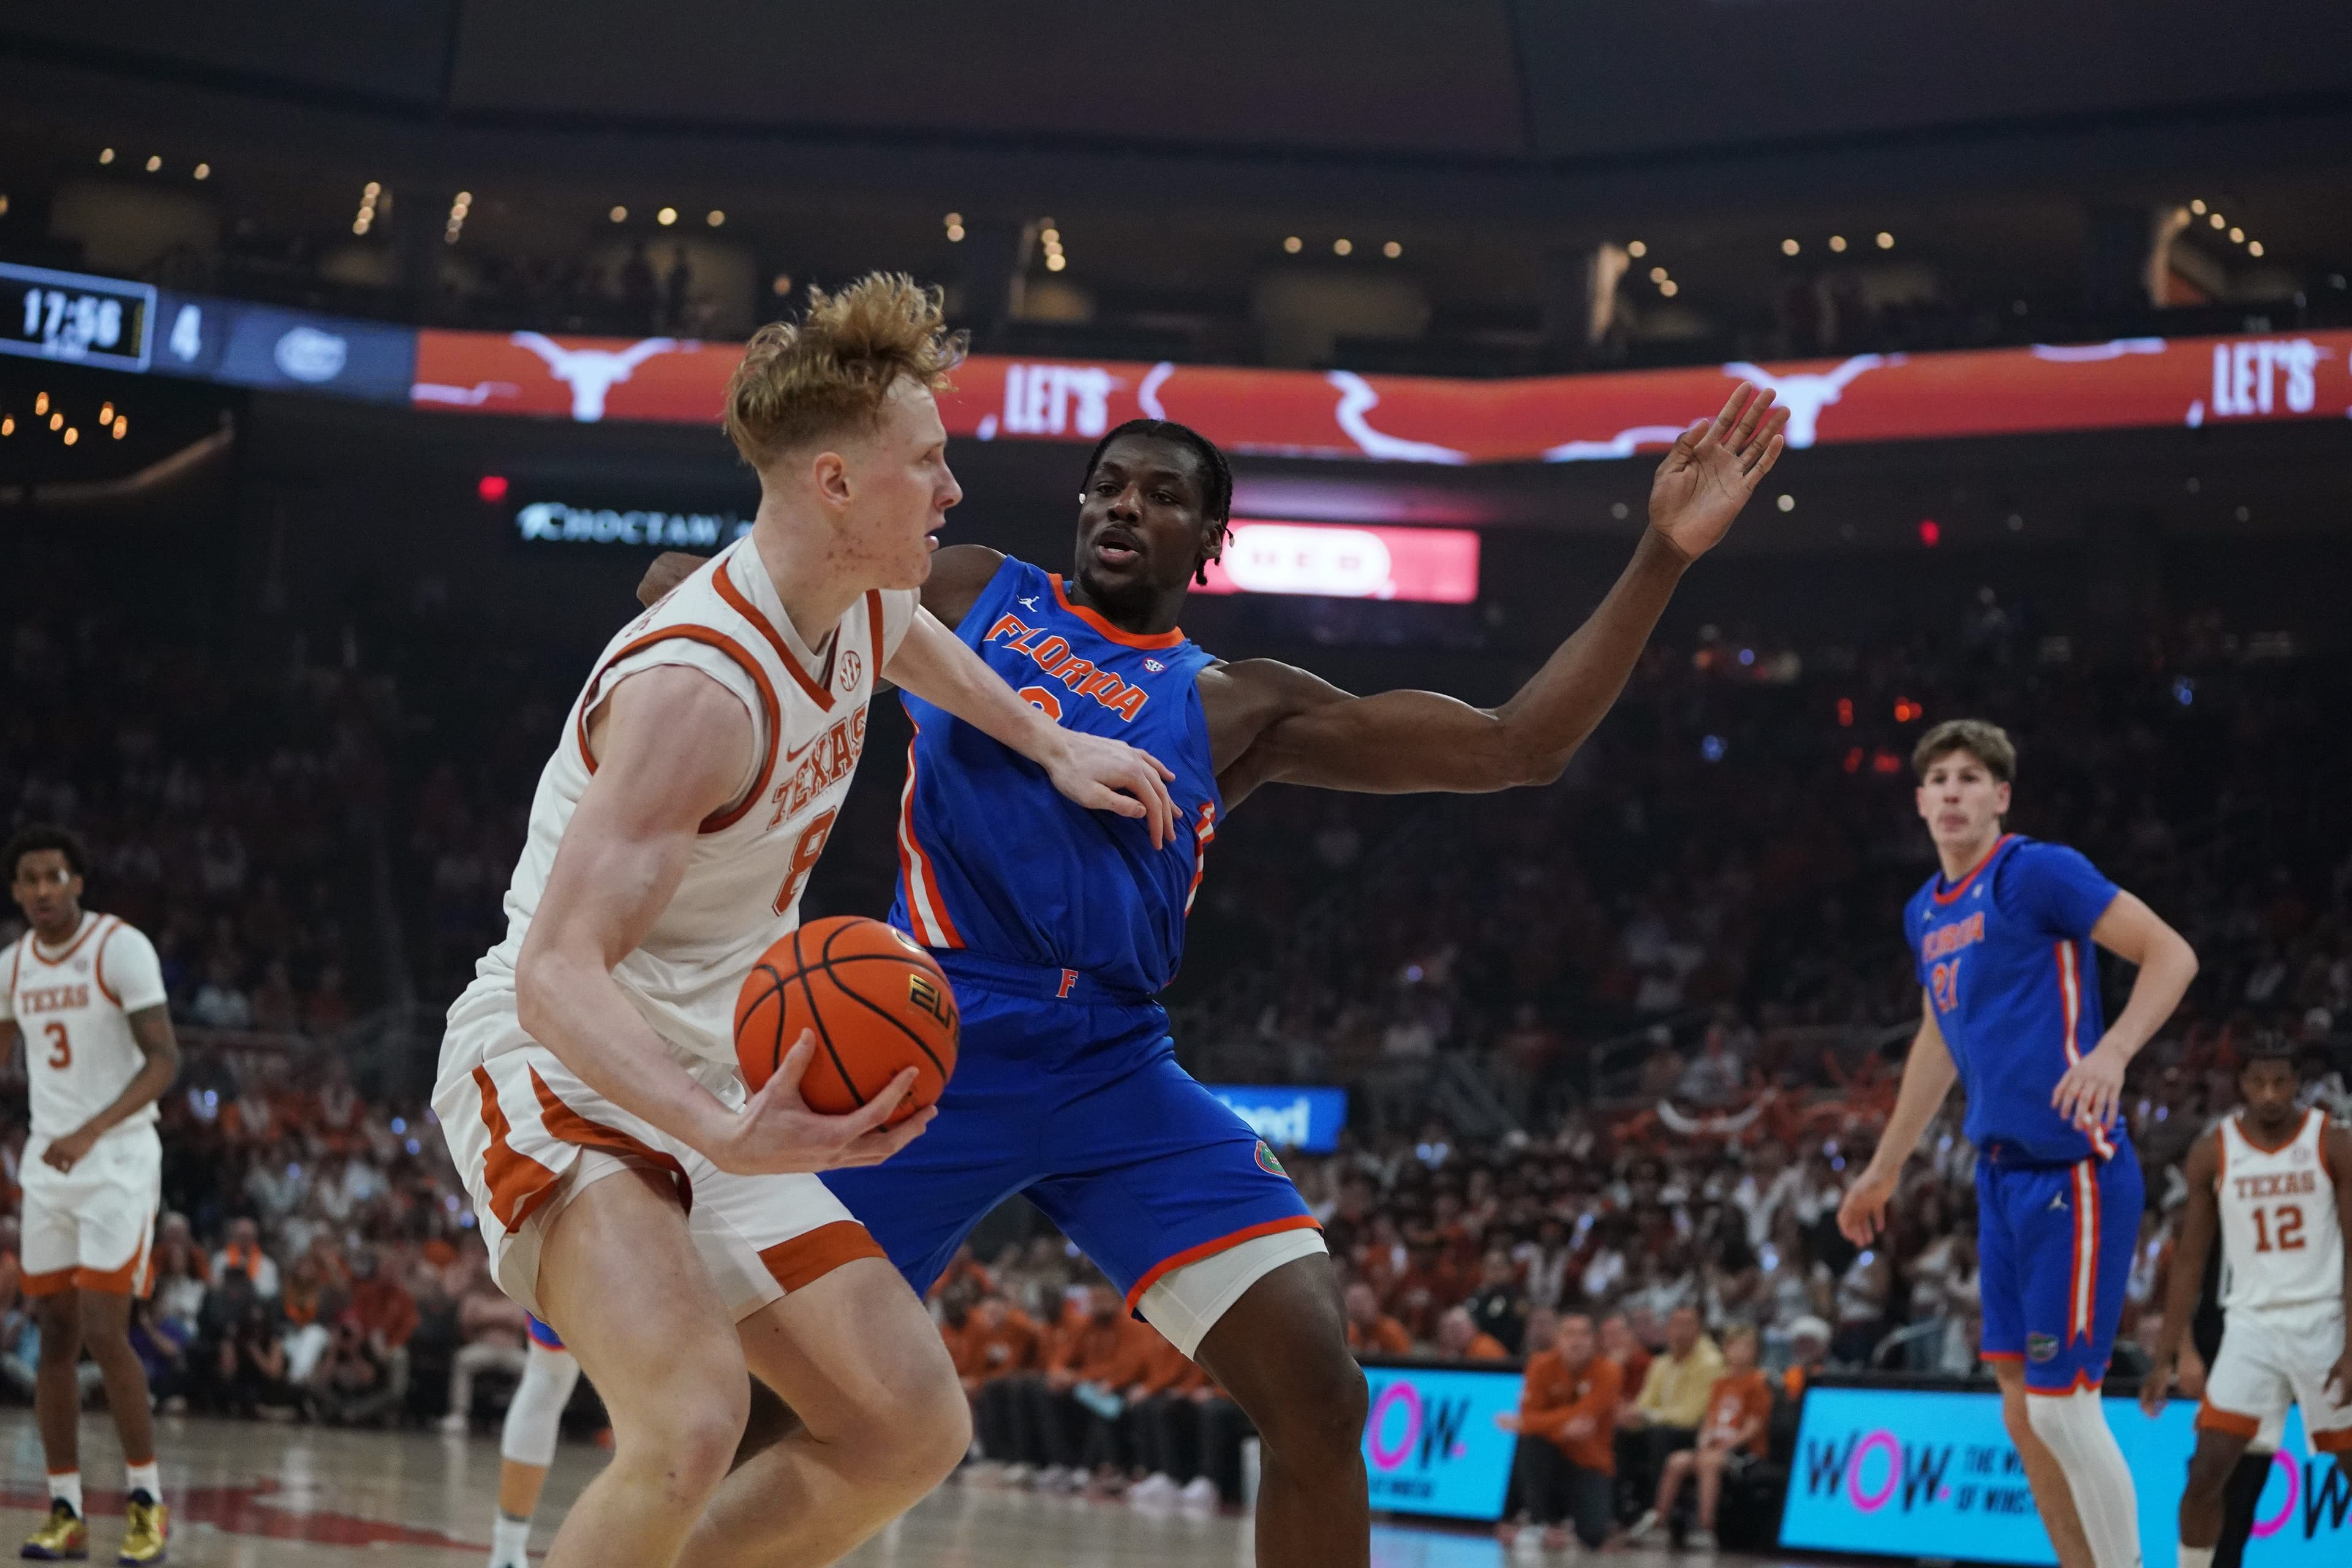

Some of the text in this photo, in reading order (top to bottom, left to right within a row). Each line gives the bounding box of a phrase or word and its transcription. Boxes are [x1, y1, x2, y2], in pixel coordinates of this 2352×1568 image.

[170, 304, 202, 363] 4
[982, 611, 1150, 723] FLORIDA
[766, 701, 867, 831] TEXAS
[21, 984, 89, 1015] TEXAS
[1055, 968, 1079, 998] F
[44, 1021, 72, 1071] 3
[2234, 1169, 2316, 1200] TEXAS
[2252, 1204, 2307, 1253] 12
[1367, 1379, 1471, 1473] OW.
